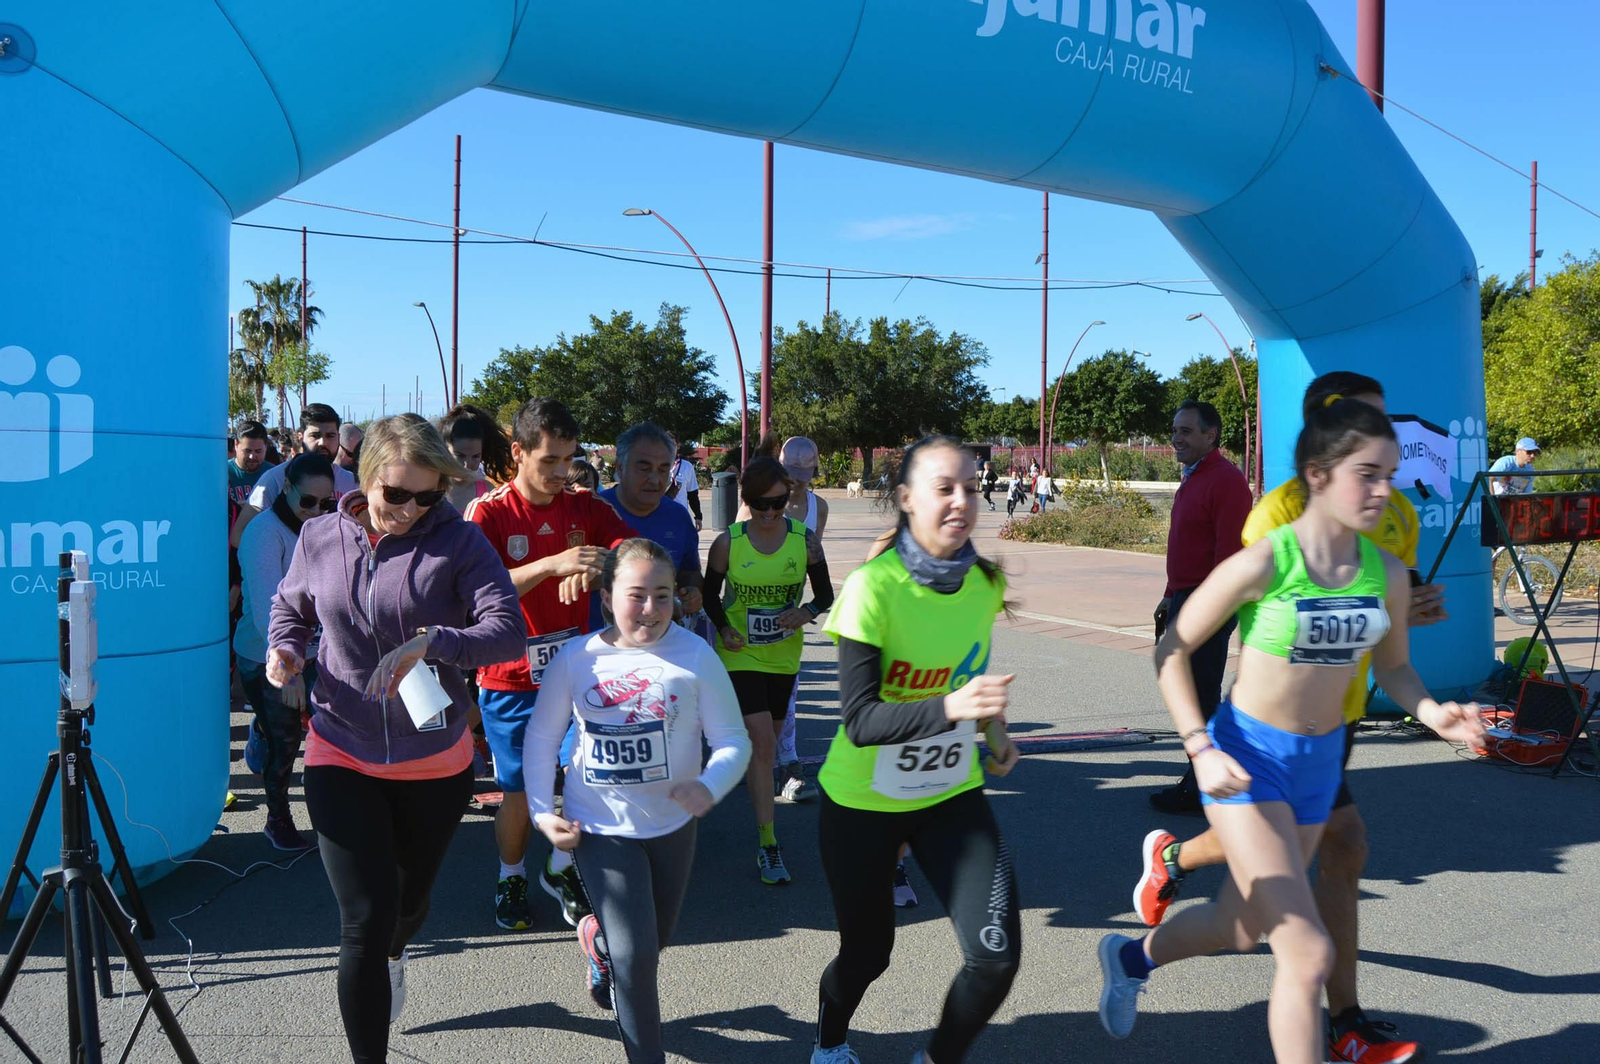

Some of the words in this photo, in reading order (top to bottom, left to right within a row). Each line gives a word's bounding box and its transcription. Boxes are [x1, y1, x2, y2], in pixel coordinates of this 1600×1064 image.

[1055, 36, 1114, 75] CAJA
[1122, 53, 1193, 94] RURAL
[0, 519, 172, 568] mar
[733, 582, 788, 595] RUNNERS
[1308, 613, 1368, 645] 5012
[885, 659, 952, 690] Run
[591, 737, 653, 766] 4959
[895, 742, 964, 772] 526
